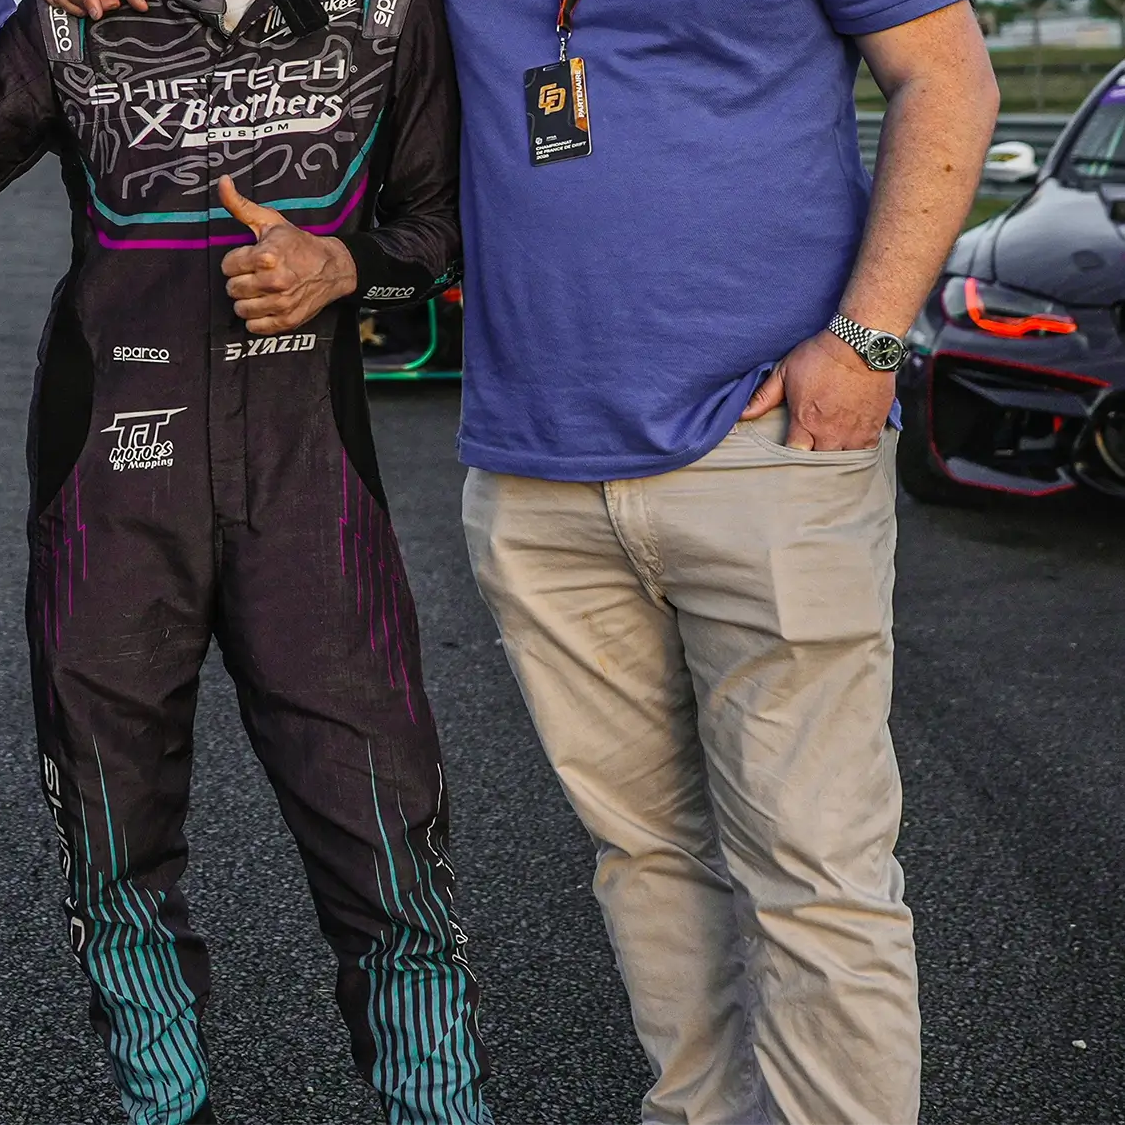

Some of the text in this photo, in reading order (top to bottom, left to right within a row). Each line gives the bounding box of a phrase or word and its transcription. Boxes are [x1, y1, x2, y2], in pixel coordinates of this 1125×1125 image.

[49, 5, 72, 53] arco
[89, 59, 346, 106] SHIFTECH
[574, 70, 586, 118] PARTENAIRE
[128, 83, 344, 148] X Brothers
[206, 122, 290, 142] CUSTOM
[535, 140, 572, 151] CHAMPIONNAT
[543, 146, 563, 154] FRANCE
[363, 286, 415, 301] sparco
[113, 346, 170, 363] sparco
[109, 440, 174, 464] MOTORS
[113, 456, 174, 472] By Mapping
